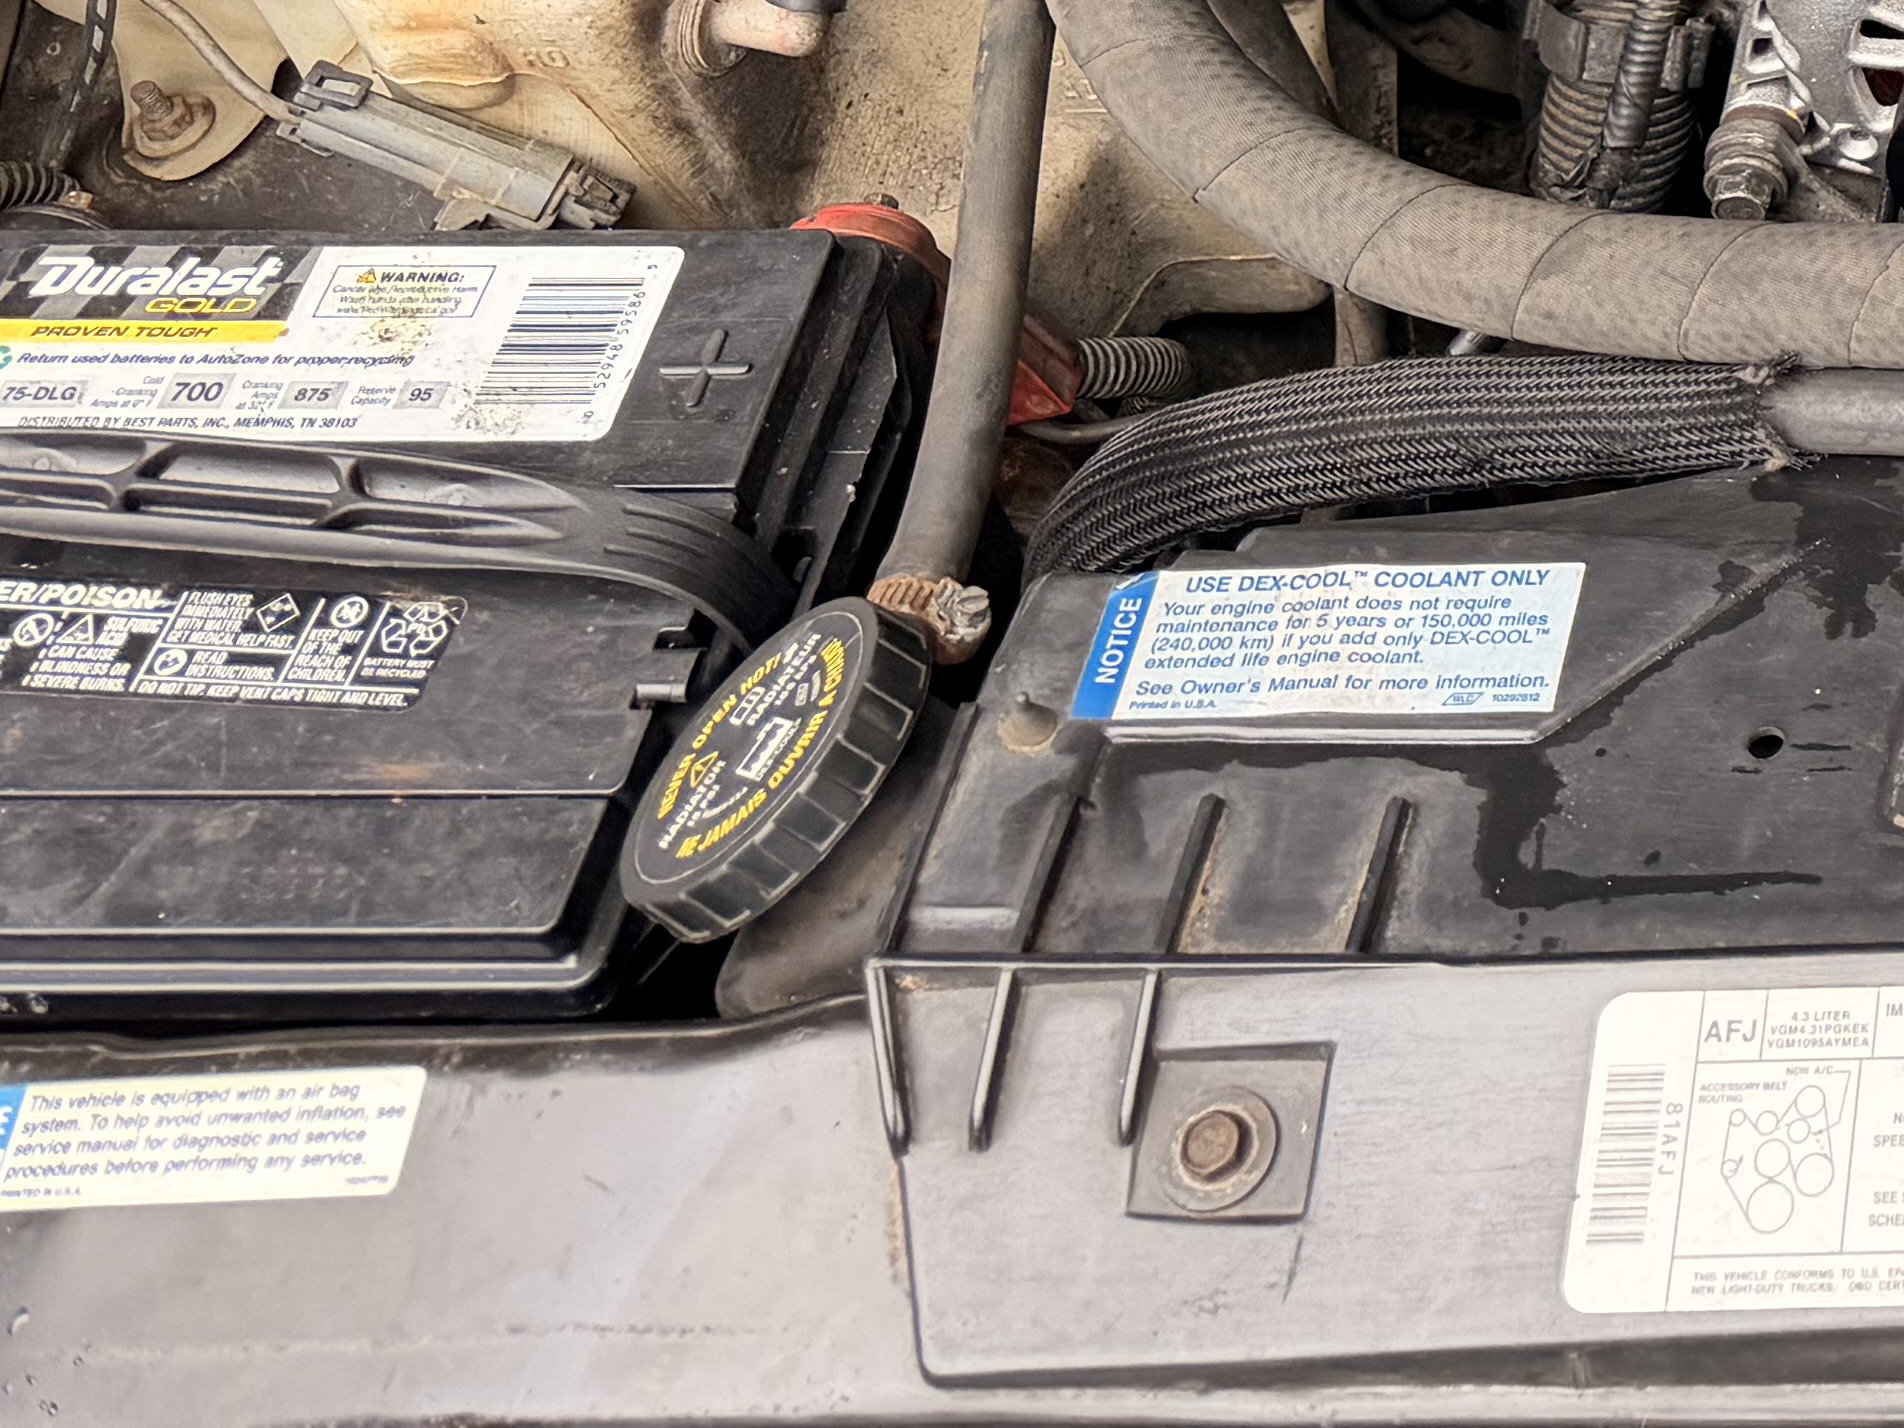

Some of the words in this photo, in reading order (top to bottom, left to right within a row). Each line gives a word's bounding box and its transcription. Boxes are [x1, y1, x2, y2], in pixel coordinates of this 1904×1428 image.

[29, 256, 284, 296] Duralast
[380, 272, 465, 283] WARNING:
[145, 297, 257, 313] GOLD
[31, 326, 129, 337] PROVEN
[17, 352, 68, 364] Return
[72, 353, 109, 364] used
[110, 353, 174, 364] batteries
[179, 354, 193, 364] to
[196, 353, 268, 365] AutoZone
[272, 354, 292, 365] for
[2, 386, 77, 401] 75-DLG
[170, 382, 224, 402] 700
[294, 388, 332, 402] 875
[408, 387, 434, 402] 95
[18, 416, 99, 428] DISTRIBUTED
[103, 417, 120, 428] BY
[124, 417, 155, 427] BEST
[158, 417, 198, 428] PARTS,
[233, 417, 295, 429] MEMPHIS,
[300, 418, 315, 428] TN
[319, 417, 359, 428] 38103
[1186, 576, 1232, 593] USE
[1374, 570, 1486, 588] COOLANT
[1491, 569, 1550, 586] ONLY
[1164, 602, 1204, 617] Your
[1211, 600, 1275, 618] engine
[1281, 596, 1349, 614] coolant
[1356, 597, 1402, 610] does
[1410, 597, 1439, 610] not
[1445, 595, 1512, 612] require
[1156, 620, 1278, 634] maintenance
[1286, 616, 1311, 630] for
[1316, 615, 1328, 628] 5
[1335, 615, 1387, 630] years
[1394, 617, 1415, 628] or
[1421, 613, 1492, 629] 150,000
[1499, 612, 1548, 626] miles
[96, 632, 128, 646] ACID
[167, 630, 190, 642] GET
[191, 632, 234, 644] MEDICAL
[237, 634, 264, 646] HELP
[264, 635, 295, 649] FAST.
[308, 629, 337, 641] KEEP
[338, 630, 364, 642] OUT
[1095, 597, 1142, 684] NOTICE
[1151, 636, 1233, 654] (240,000
[1239, 635, 1274, 651] km)
[1281, 633, 1294, 647] if
[1298, 634, 1333, 649] you
[1339, 632, 1376, 645] add
[1383, 632, 1424, 649] only
[48, 646, 72, 658] CAN
[76, 647, 119, 661] CAUSE
[192, 651, 229, 664] READ
[1145, 653, 1234, 669] extended
[1241, 652, 1269, 667] life
[1276, 649, 1340, 667] engine
[1348, 650, 1423, 664] coolant.
[30, 675, 77, 687] SEVERE
[185, 664, 274, 681] INSTRUCTIONS.
[288, 667, 346, 682] CHILDREN.
[747, 633, 822, 726] RADIATEUR
[1135, 680, 1173, 696] See
[1180, 678, 1261, 694] Owner's
[1267, 674, 1337, 692] Manual
[1345, 674, 1373, 690] for
[1378, 676, 1429, 690] more
[1435, 673, 1550, 689] information.
[658, 753, 696, 819] NEVER
[692, 695, 738, 749] OPEN
[698, 788, 768, 852] JAMAIS
[768, 711, 828, 789] OUVRIR
[659, 759, 726, 849] RADIATOR
[1814, 1011, 1851, 1021] LITER
[1703, 1019, 1757, 1043] AFJ
[30, 1095, 63, 1112] This
[69, 1091, 126, 1109] vehicle
[131, 1091, 145, 1106] is
[151, 1088, 230, 1108] equipped
[236, 1086, 271, 1101] with
[275, 1087, 297, 1101] an
[301, 1084, 324, 1100] air
[328, 1083, 360, 1102] bag
[1658, 1102, 1683, 1176] 81AFJ
